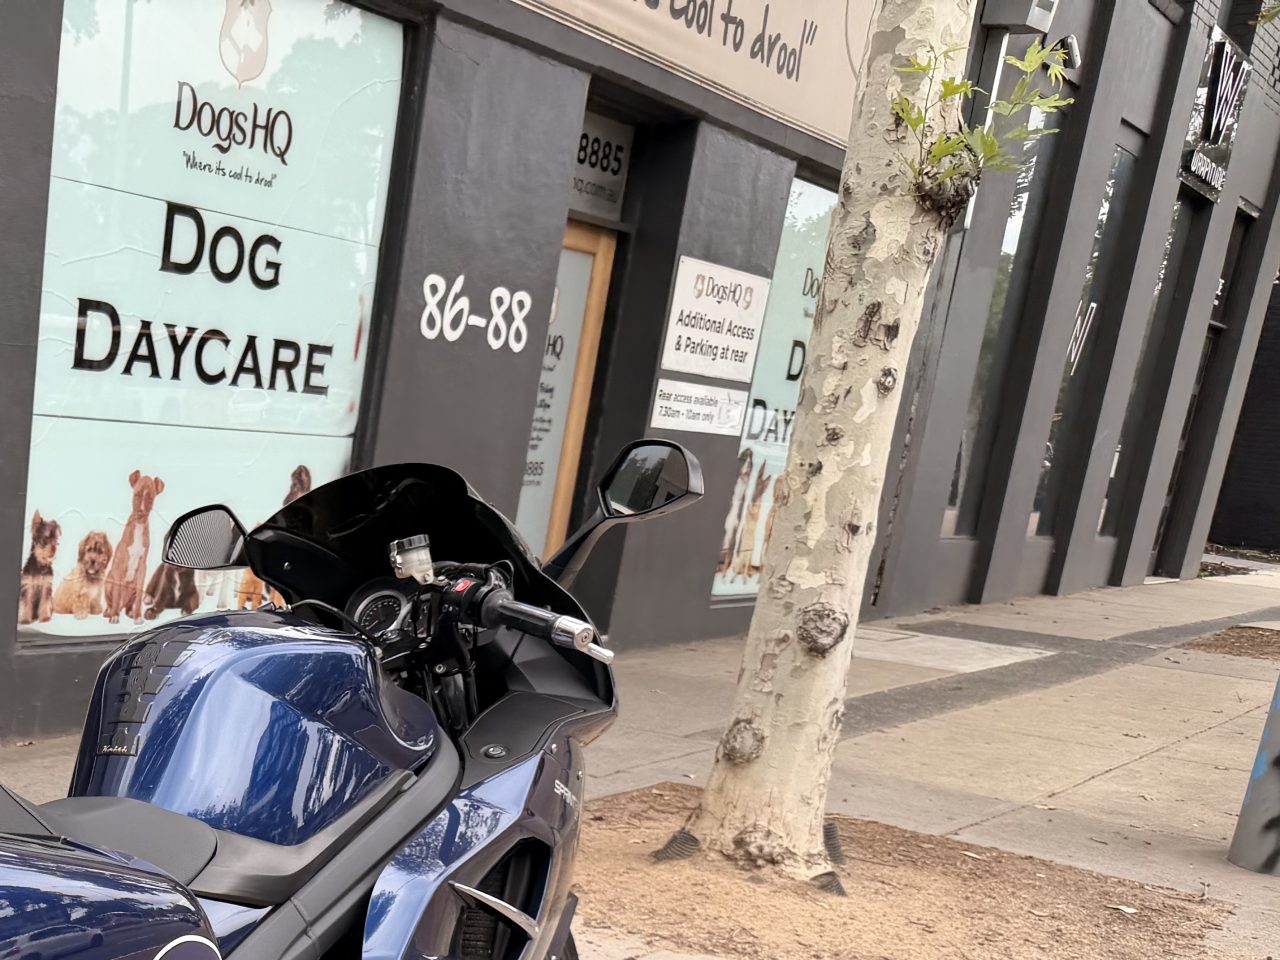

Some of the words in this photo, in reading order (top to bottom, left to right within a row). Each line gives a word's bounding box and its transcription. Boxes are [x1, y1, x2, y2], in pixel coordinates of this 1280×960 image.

[720, 0, 745, 52] to
[577, 132, 624, 176] 8885
[159, 200, 282, 290] DOG
[420, 273, 532, 353] 86-88
[676, 308, 726, 335] Additional
[725, 320, 756, 341] Access
[71, 297, 334, 396] DAYCARE
[674, 334, 683, 352] &
[683, 336, 719, 361] Parking
[719, 345, 730, 360] at
[730, 349, 749, 363] rear
